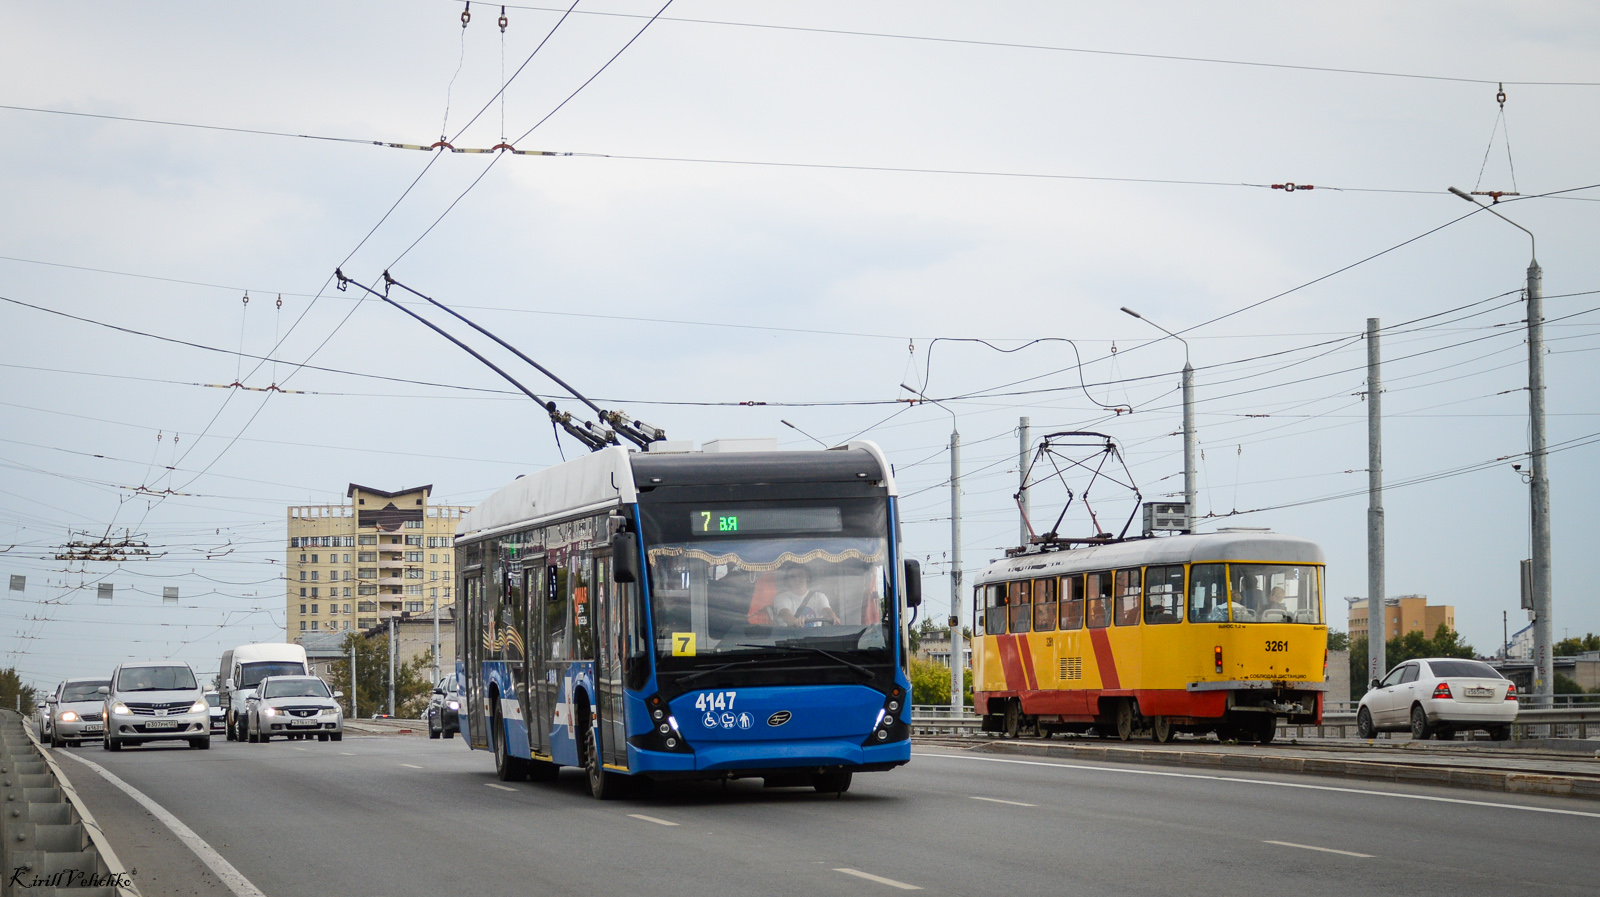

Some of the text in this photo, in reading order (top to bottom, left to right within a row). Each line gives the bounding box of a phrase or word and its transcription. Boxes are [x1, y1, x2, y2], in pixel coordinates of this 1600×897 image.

[701, 511, 738, 532] 7 ая
[677, 637, 691, 653] 7
[1265, 640, 1288, 652] 3261
[695, 691, 737, 711] 4147
